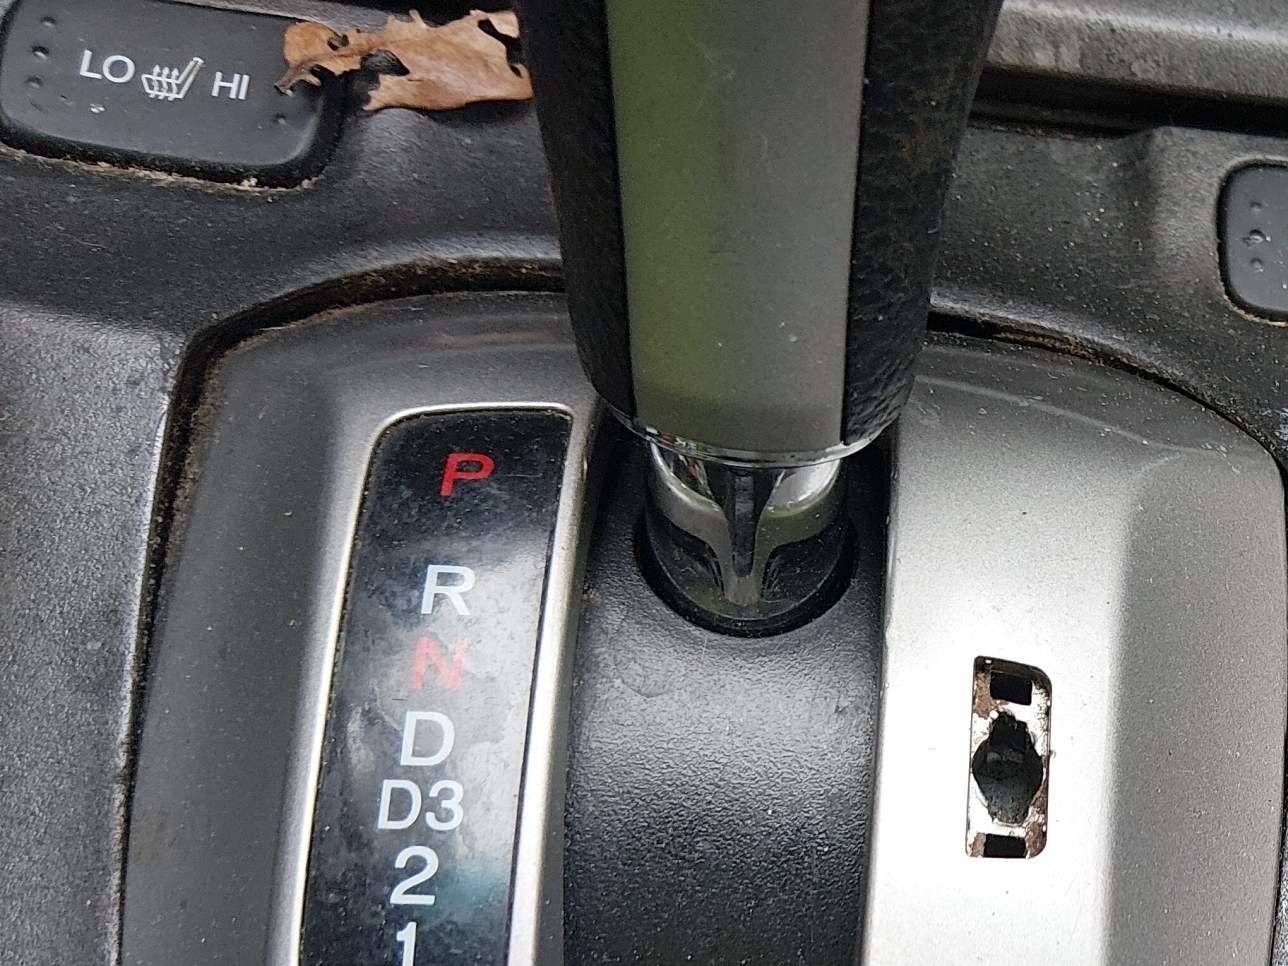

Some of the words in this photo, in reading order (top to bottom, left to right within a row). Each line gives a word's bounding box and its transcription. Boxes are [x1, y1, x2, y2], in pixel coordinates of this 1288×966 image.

[79, 50, 136, 83] LO
[211, 71, 250, 100] HI
[439, 452, 495, 498] P
[420, 564, 476, 616] R
[410, 634, 470, 690] N
[400, 711, 455, 767] D
[377, 778, 464, 831] D3
[389, 845, 440, 906] 2
